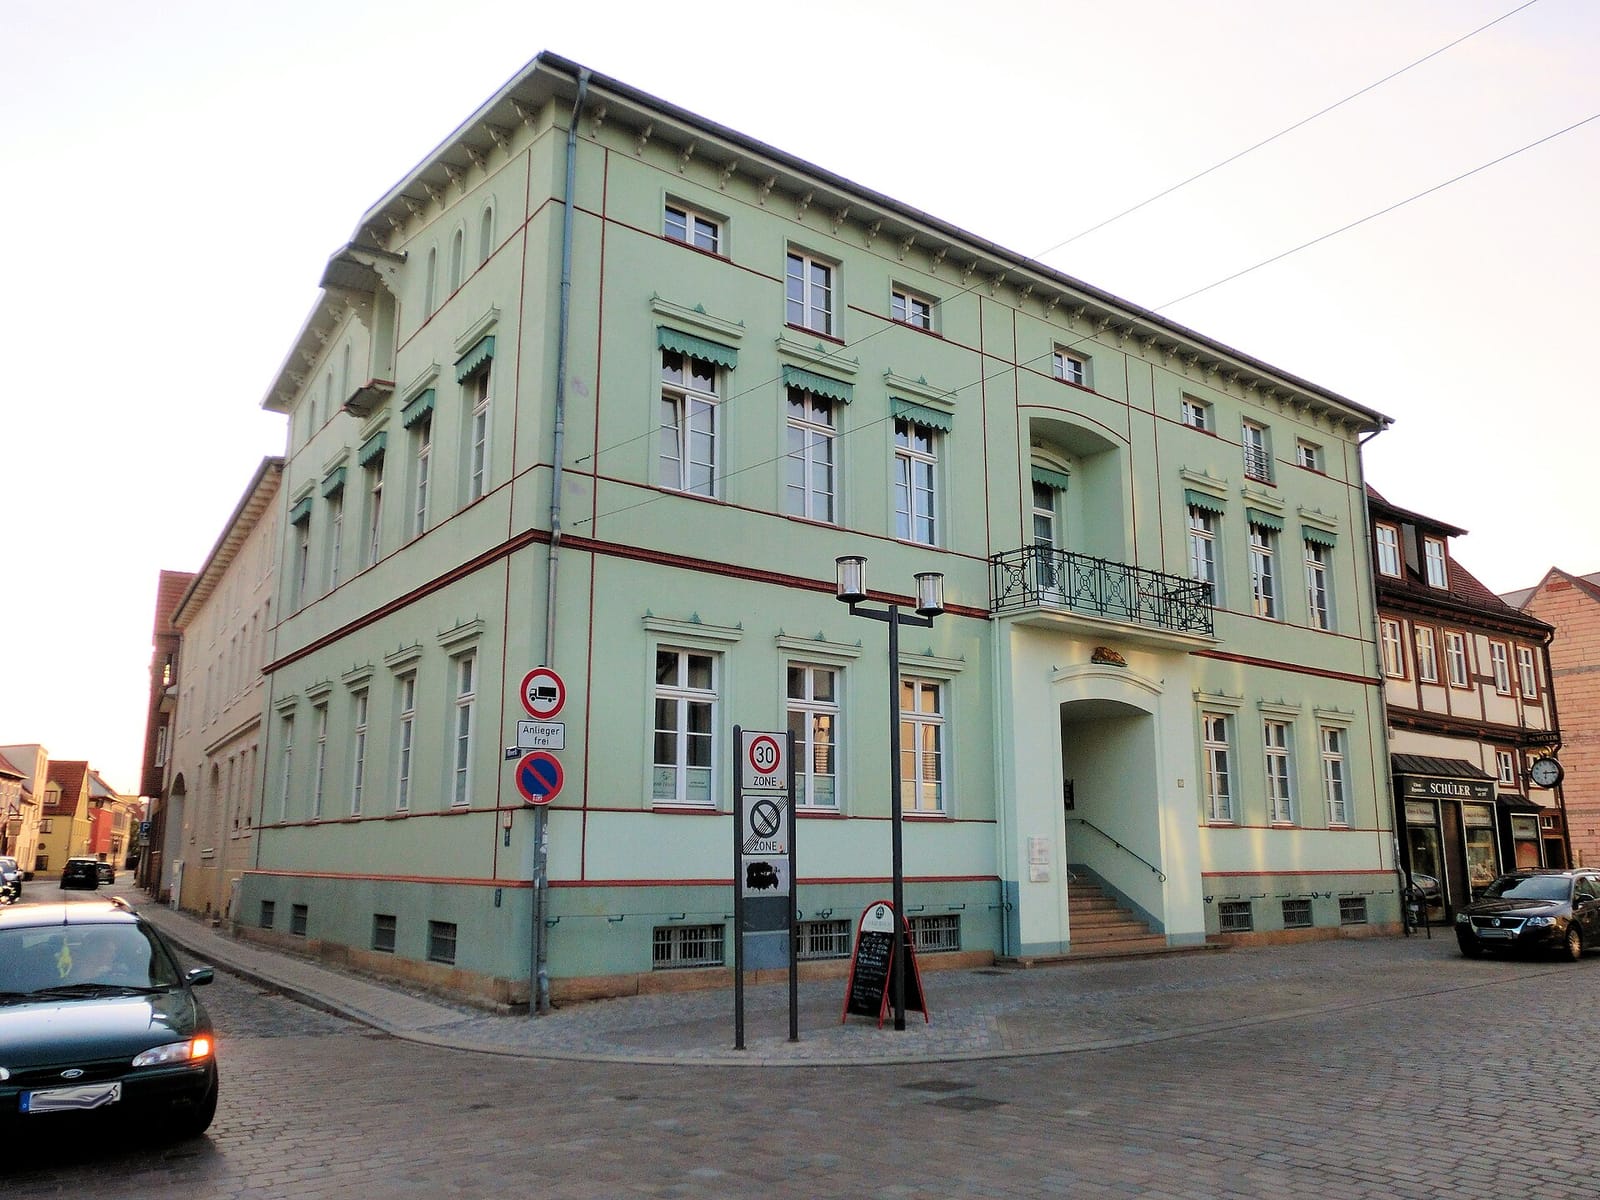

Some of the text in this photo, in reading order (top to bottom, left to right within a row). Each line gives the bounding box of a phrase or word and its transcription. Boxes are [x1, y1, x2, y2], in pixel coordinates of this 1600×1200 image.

[522, 725, 560, 737] Anlieger
[534, 735, 549, 746] frei
[756, 746, 774, 764] 30
[753, 776, 777, 787] ZONE
[1430, 782, 1471, 796] SCHÜLER
[754, 841, 777, 851] ZONE
